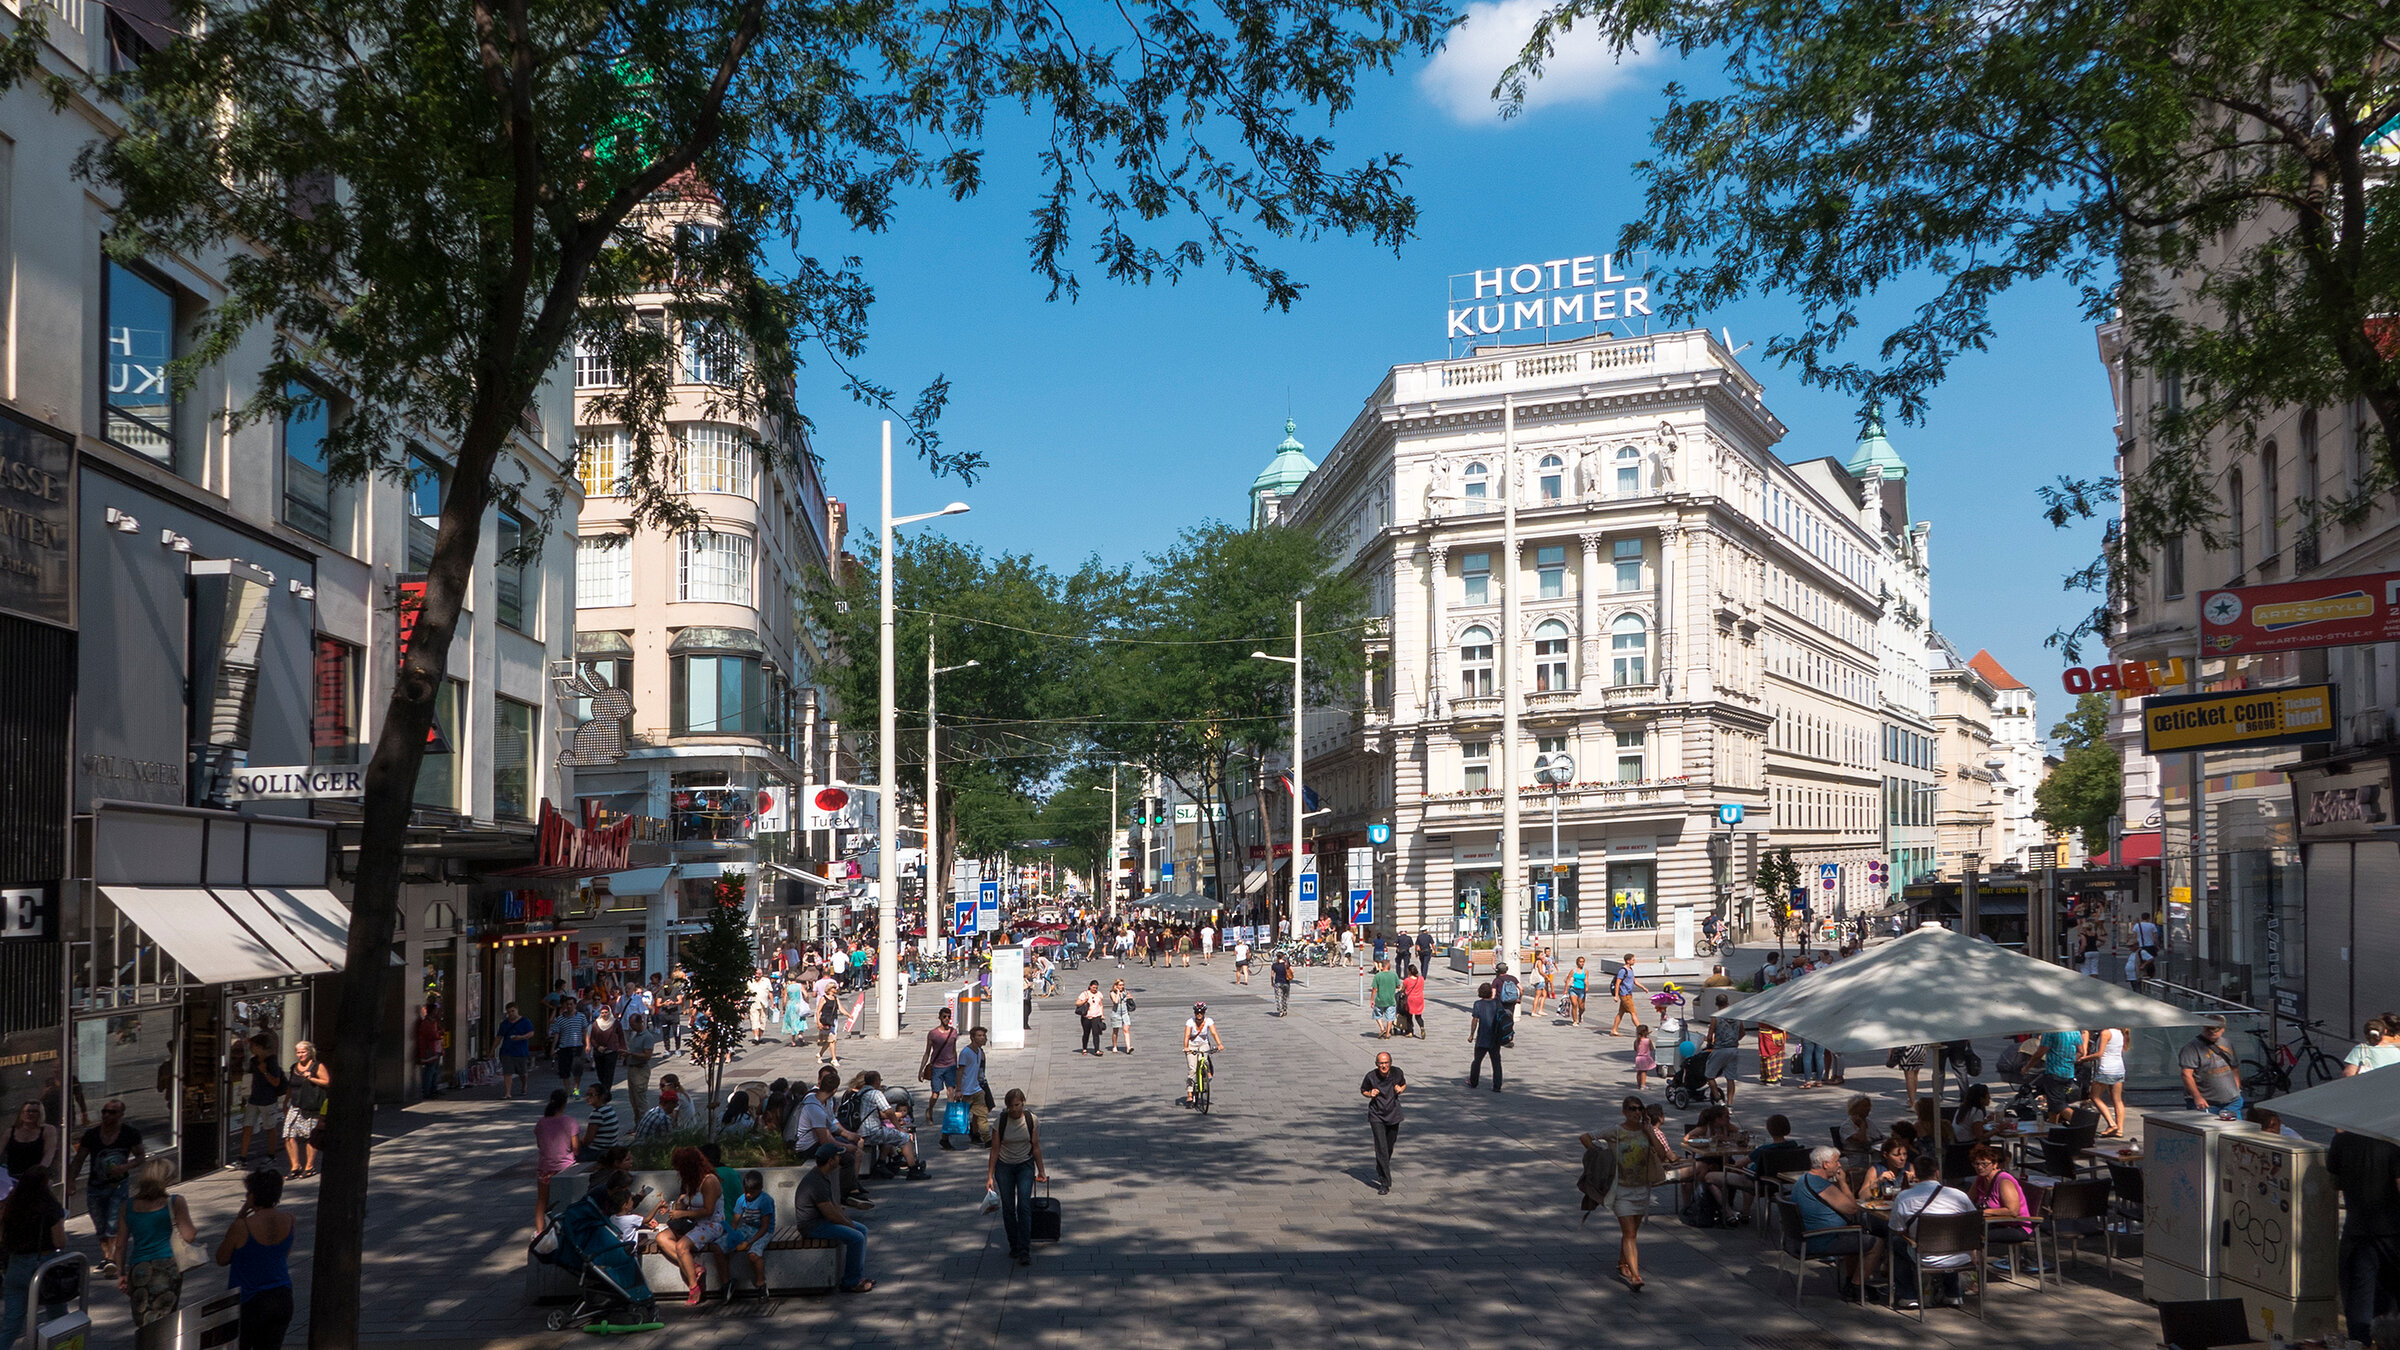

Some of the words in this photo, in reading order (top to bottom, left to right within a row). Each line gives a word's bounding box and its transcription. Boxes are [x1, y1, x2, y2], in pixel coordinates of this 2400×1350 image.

[1475, 254, 1625, 299] HOTEL
[1448, 287, 1652, 338] KUMMER
[2284, 697, 2322, 712] Tickets
[2284, 708, 2323, 728] hier!
[237, 772, 362, 795] SOLINGER
[811, 815, 852, 828] Turek
[1723, 808, 1737, 822] U
[1373, 828, 1386, 843] U
[1539, 870, 1568, 878] SAE
[596, 959, 639, 970] SALE
